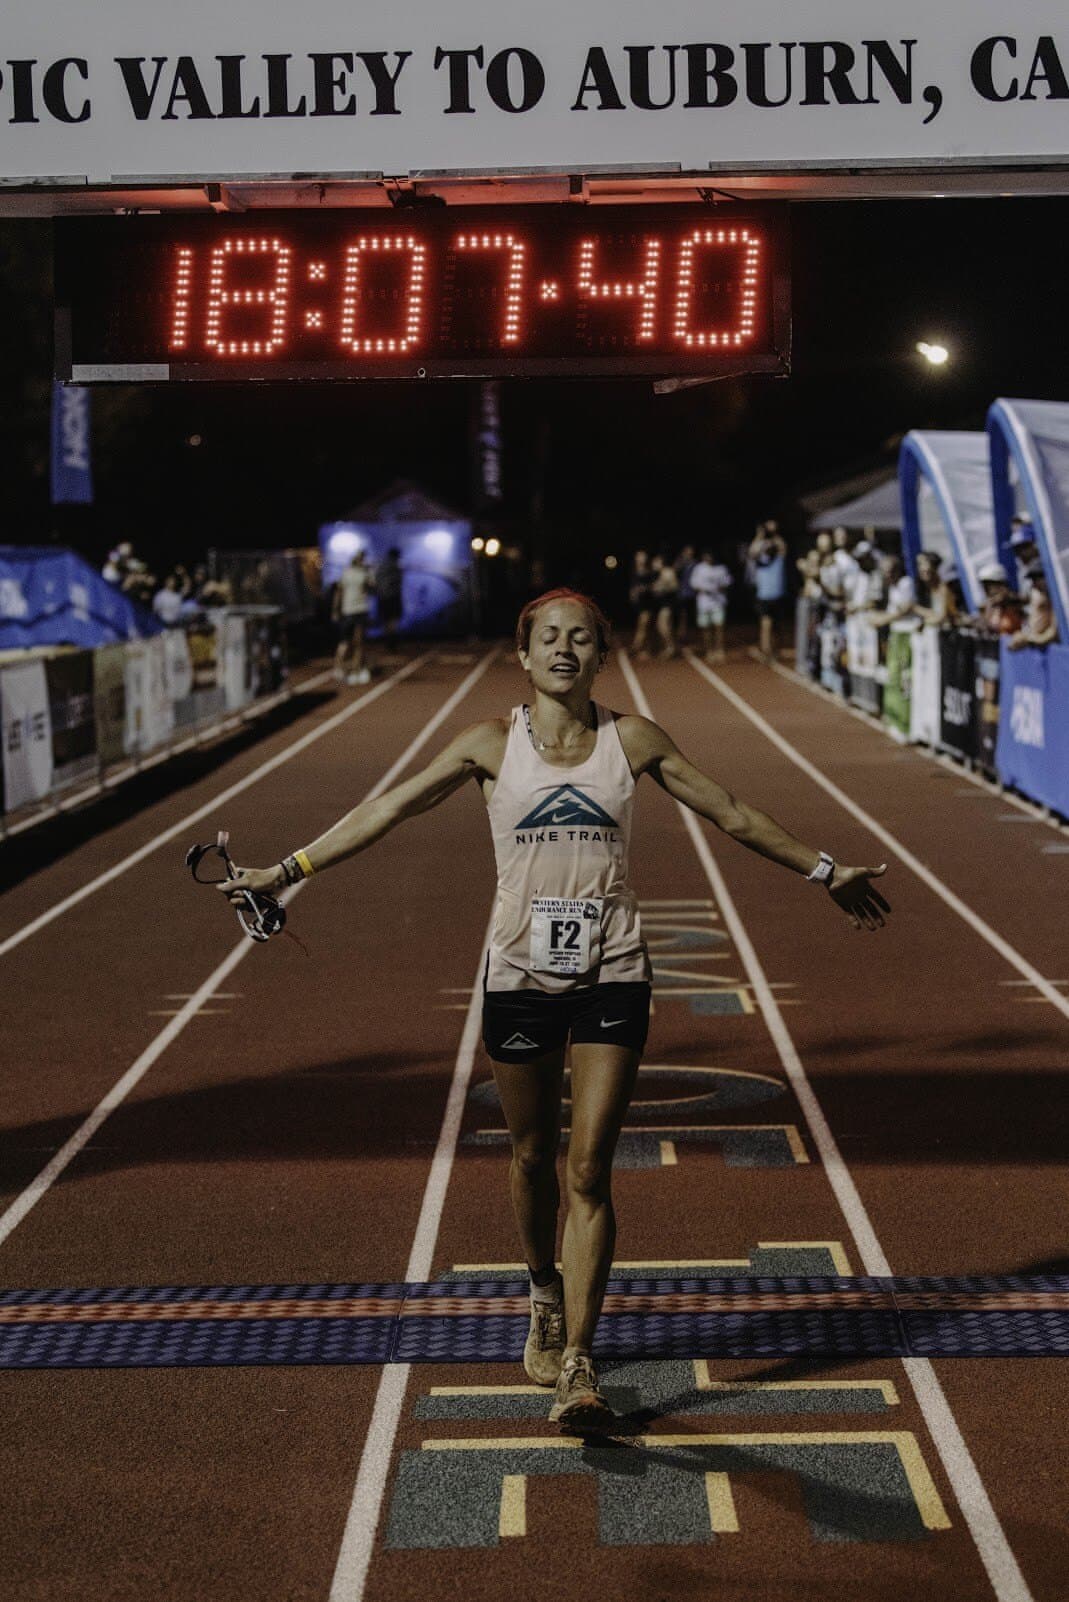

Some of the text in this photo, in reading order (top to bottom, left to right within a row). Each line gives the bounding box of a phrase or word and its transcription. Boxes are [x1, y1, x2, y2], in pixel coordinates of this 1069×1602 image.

[0, 36, 1069, 125] IC VALLEY TO AUBURN, CA
[515, 831, 617, 845] NIKE TRAIL
[550, 920, 581, 949] F2
